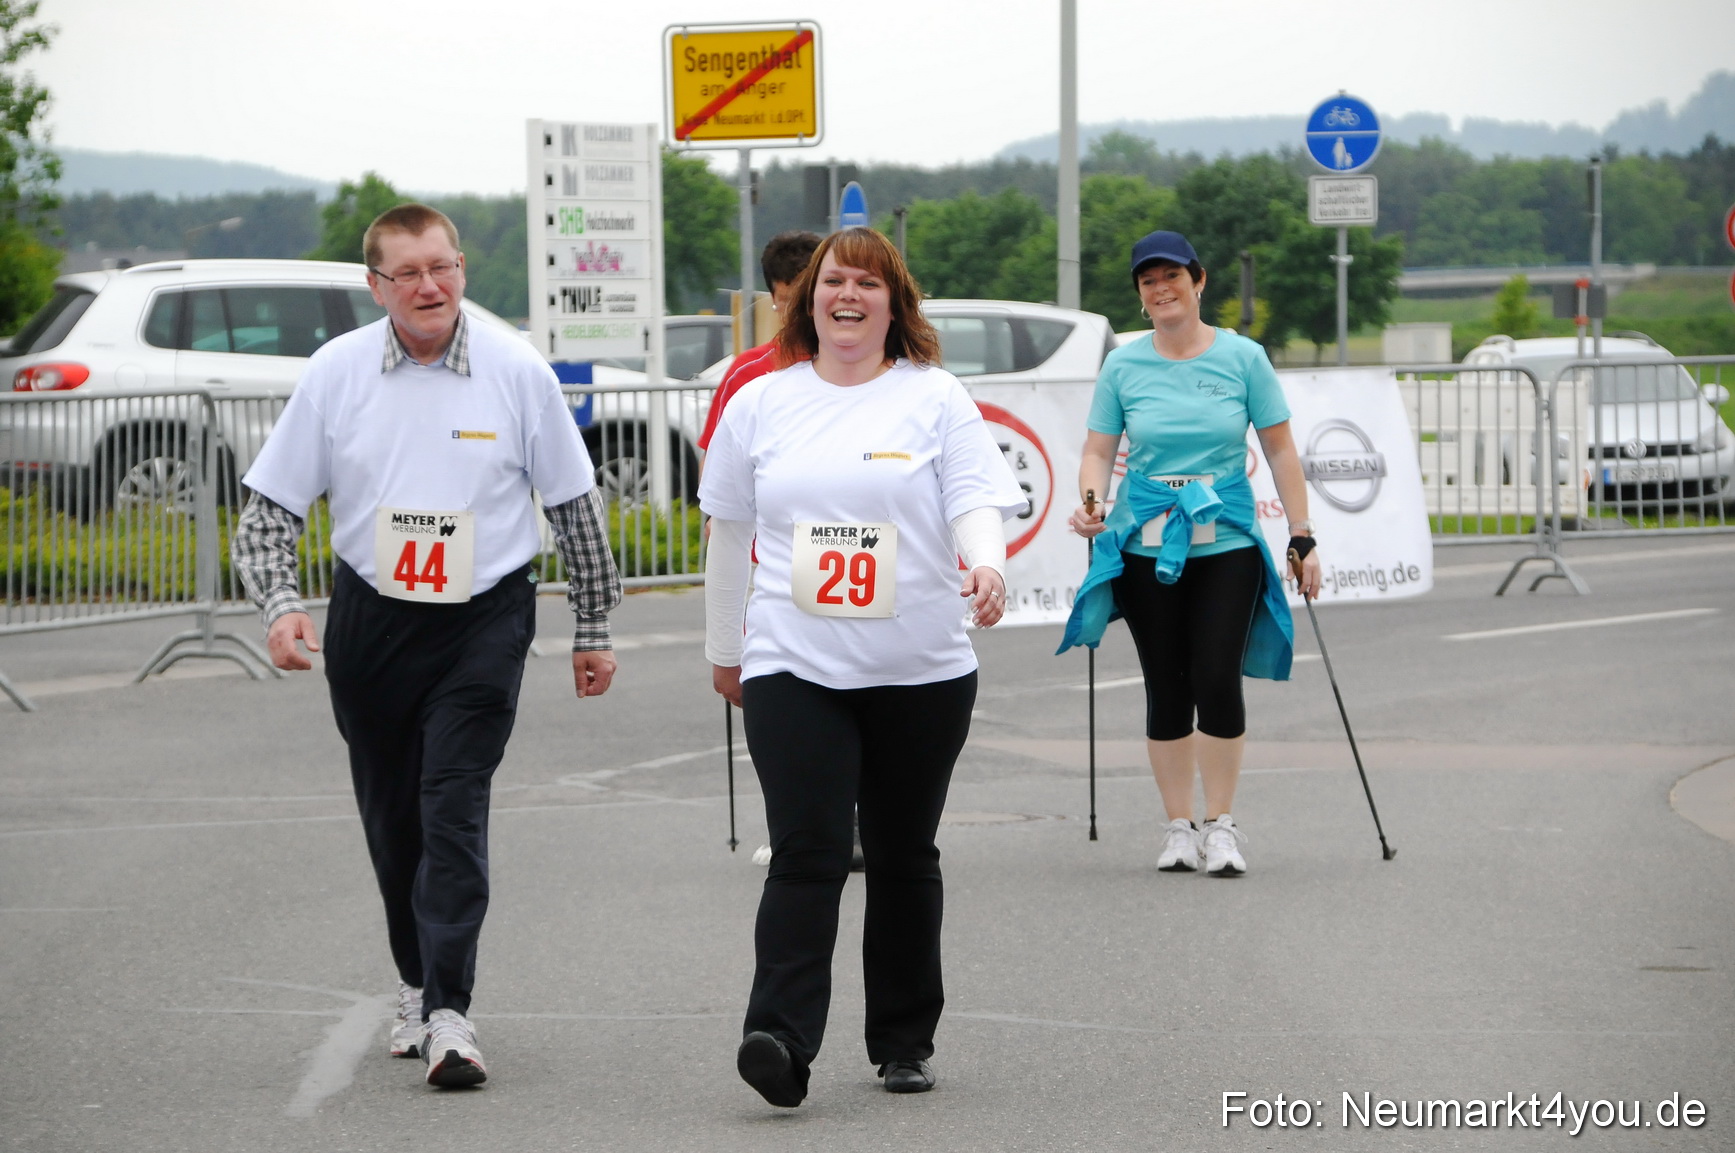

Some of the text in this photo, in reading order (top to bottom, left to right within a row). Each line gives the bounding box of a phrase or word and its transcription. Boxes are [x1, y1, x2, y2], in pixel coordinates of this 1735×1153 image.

[684, 43, 802, 79] Sengenthal
[700, 80, 787, 99] am Anger
[713, 110, 766, 125] Neumarkt
[559, 286, 602, 314] THULE
[1310, 458, 1378, 473] NISSAN
[391, 513, 436, 525] MEYER
[391, 524, 436, 534] WERBUNG
[811, 526, 858, 537] MEYER
[811, 537, 858, 546] WERBUNG
[393, 540, 448, 593] 44
[816, 550, 876, 607] 29
[1032, 586, 1062, 612] Tel.
